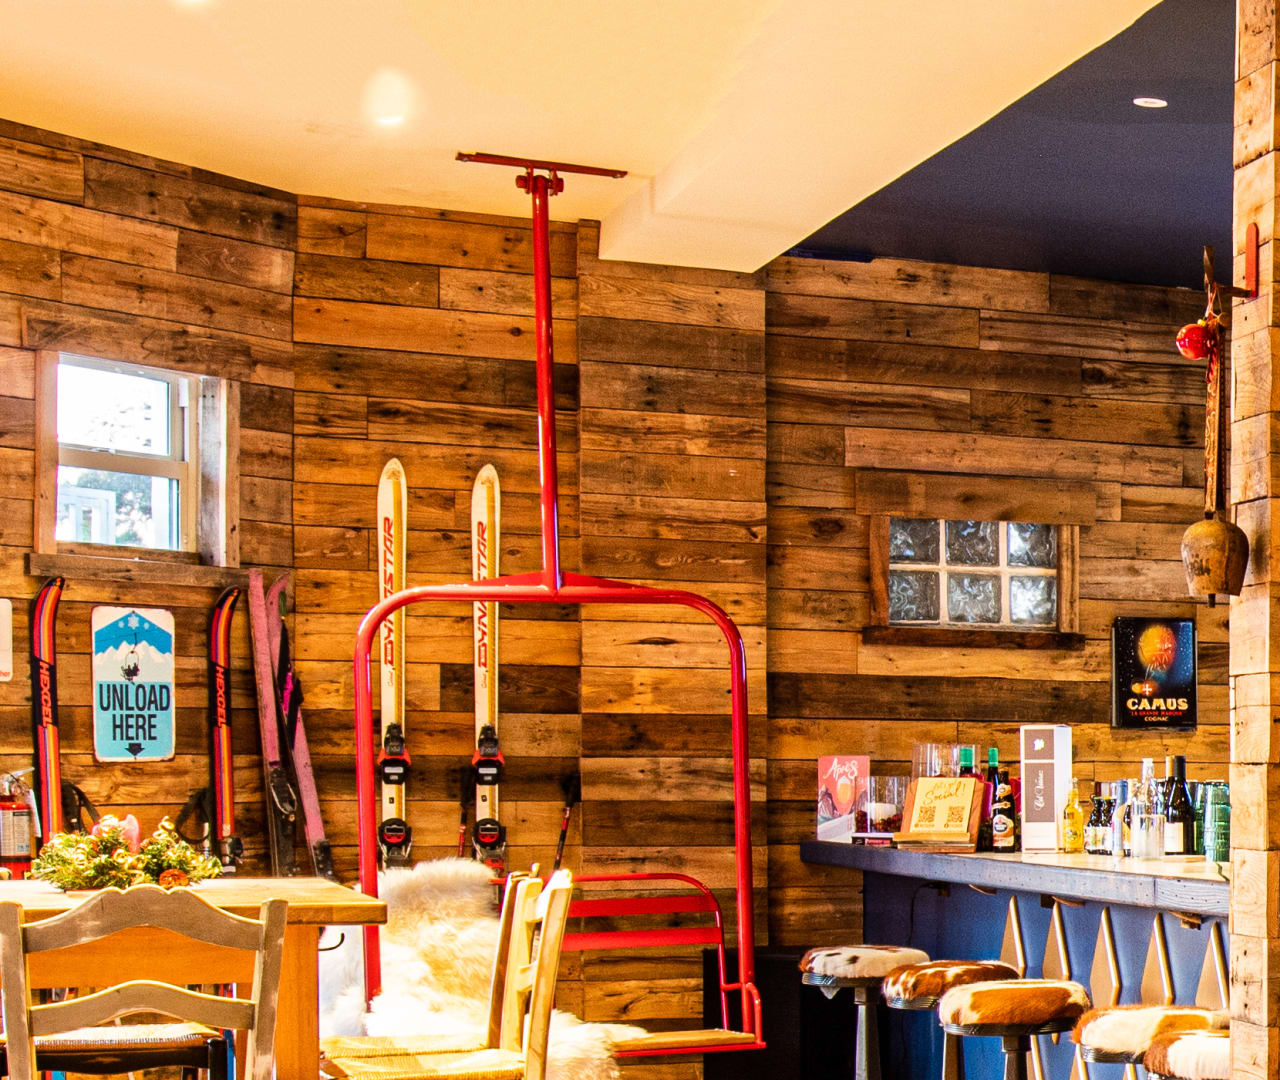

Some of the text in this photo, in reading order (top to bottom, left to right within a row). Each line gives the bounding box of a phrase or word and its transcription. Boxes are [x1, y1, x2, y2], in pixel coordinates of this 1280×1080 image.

[39, 660, 54, 728] HEXCEL
[99, 683, 171, 711] UNLOAD
[215, 665, 227, 728] HEXCEL
[1126, 698, 1189, 710] CAMUS
[112, 714, 158, 741] HERE
